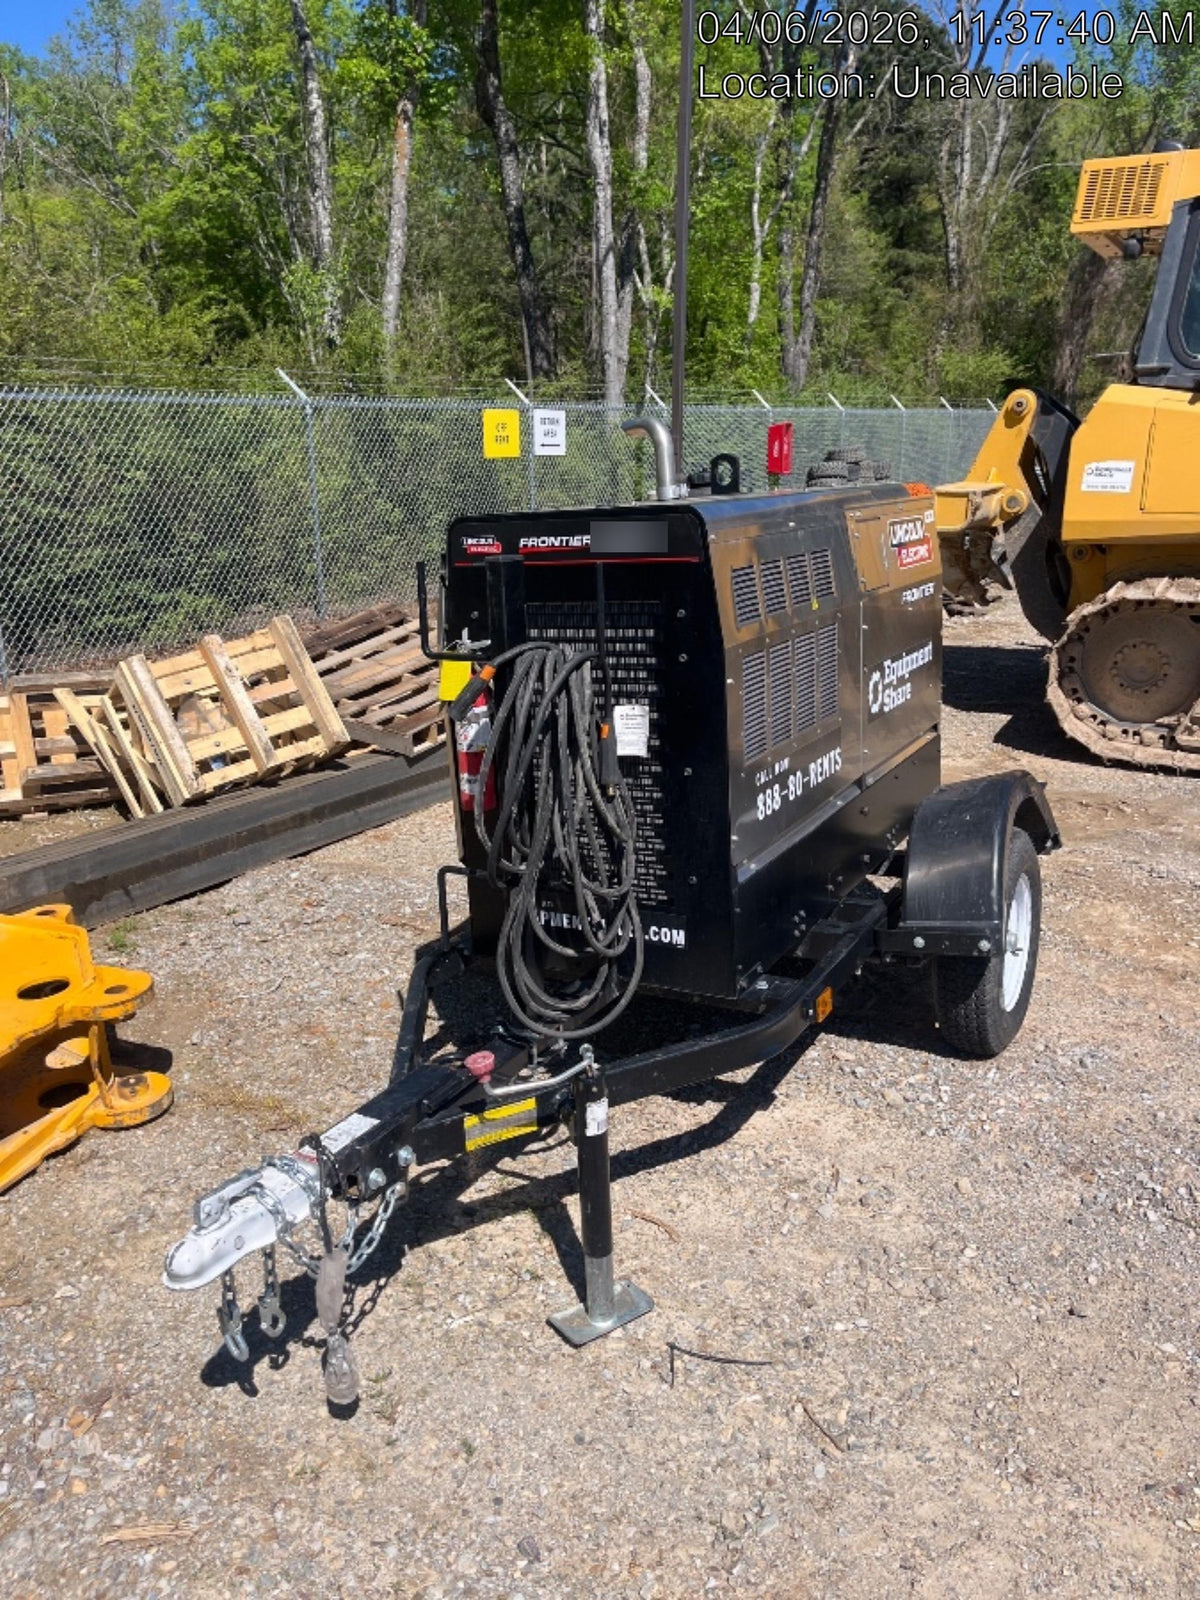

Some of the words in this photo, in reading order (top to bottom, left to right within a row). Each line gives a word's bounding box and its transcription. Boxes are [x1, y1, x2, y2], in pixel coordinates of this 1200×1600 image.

[519, 535, 591, 548] FRONTIER
[890, 520, 924, 545] LINCOLN
[901, 544, 930, 564] ELECTRIC
[883, 641, 933, 686] Equipment
[883, 682, 911, 712] Share
[756, 747, 842, 821] 888-80-RENTS
